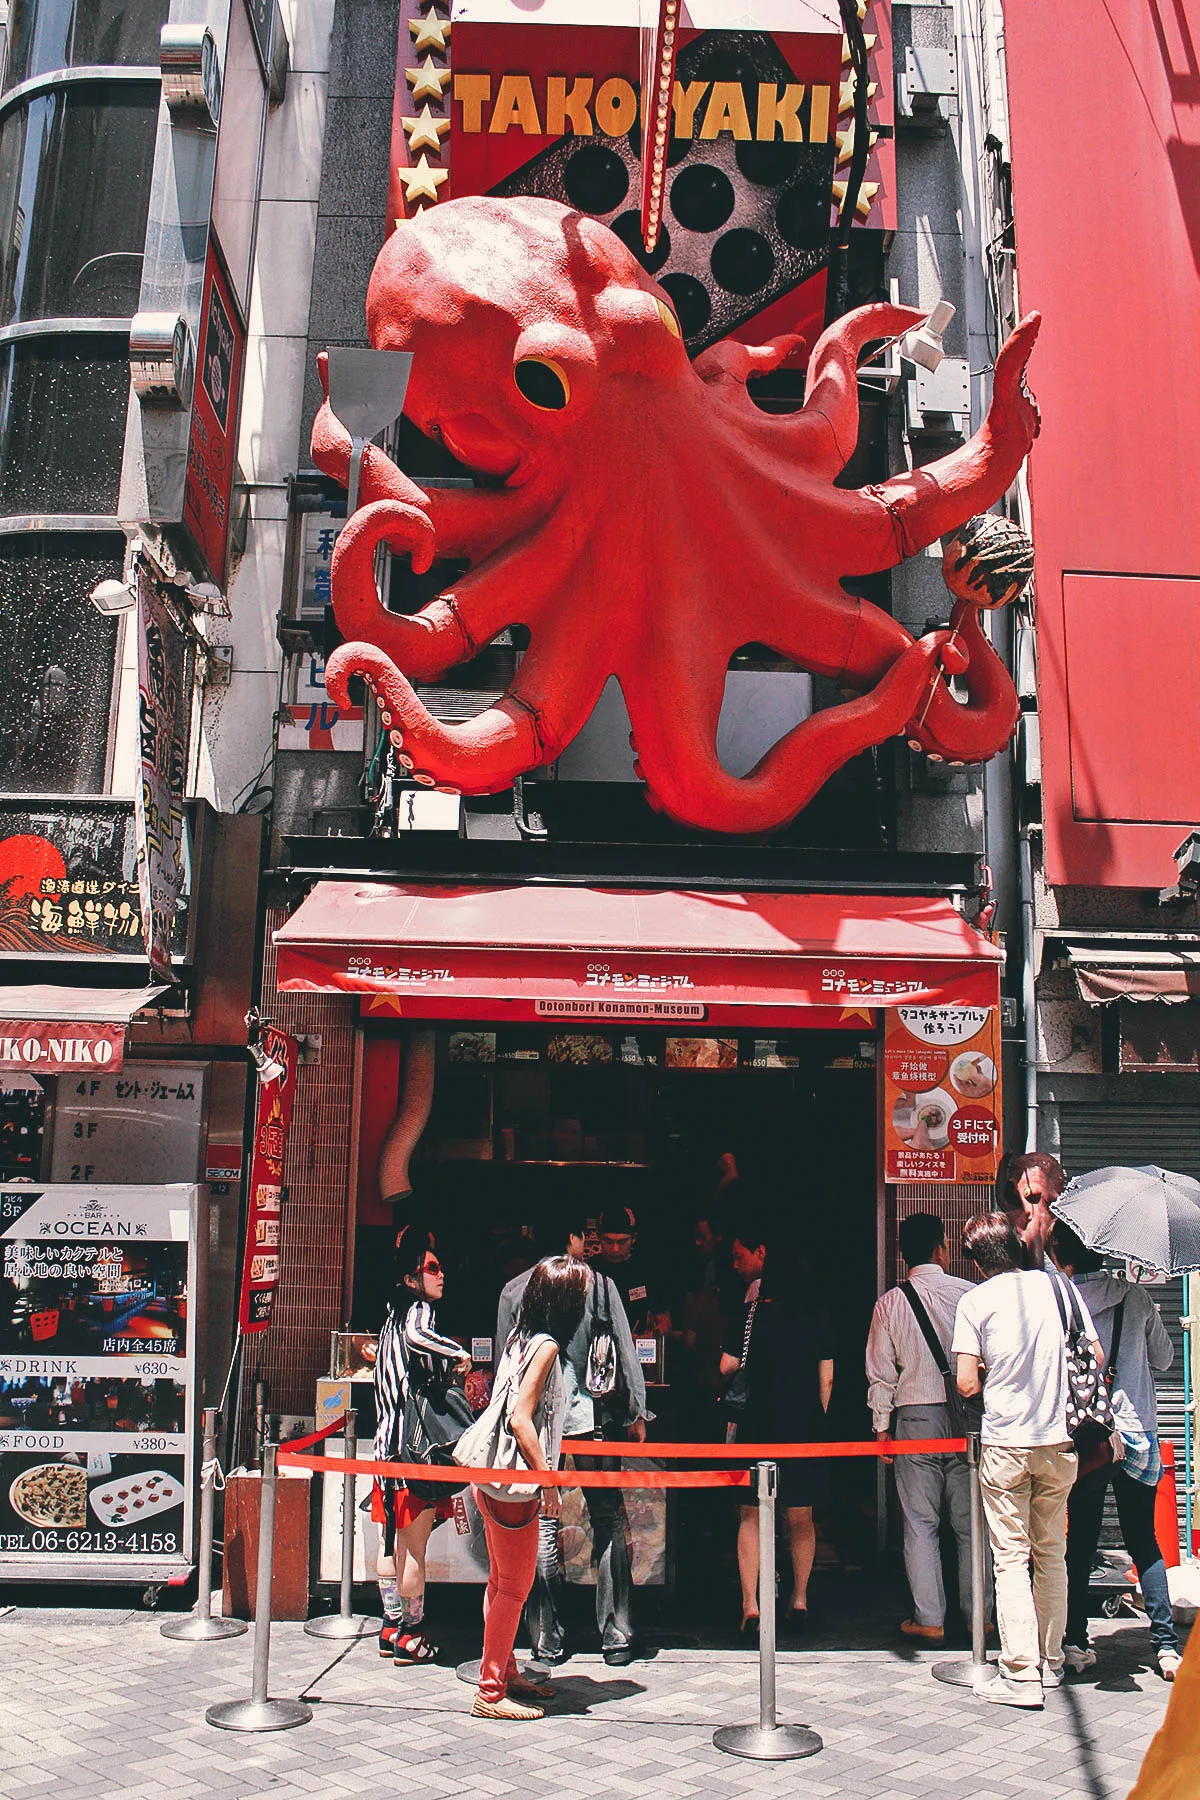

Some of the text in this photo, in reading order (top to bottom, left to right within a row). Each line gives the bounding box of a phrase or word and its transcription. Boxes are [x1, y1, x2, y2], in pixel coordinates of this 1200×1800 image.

[454, 74, 830, 143] TAKOYAKI
[30, 899, 145, 937] 海鮮物
[821, 978, 931, 993] コナモンミュージアム
[539, 1001, 701, 1015] Dotonbori Konamon-Museum
[0, 1037, 113, 1063] KO-NIKO
[76, 1081, 100, 1096] 4F
[115, 1081, 194, 1100] セント・ジェームス
[73, 1123, 98, 1138] 3F
[957, 1132, 990, 1143] 受付中
[70, 1165, 95, 1180] 2F
[207, 1169, 240, 1178] SECOM
[2, 1203, 22, 1217] 3F
[54, 1221, 131, 1236] OCEAN
[4, 1245, 124, 1261] 美味しいカクテルと
[3, 1262, 122, 1278] 居心地の良い空間
[102, 1338, 177, 1353] 店内全45席
[15, 1360, 77, 1373] DRINK
[13, 1436, 64, 1448] FOOD
[0, 1531, 177, 1552] TEL 06-6213-4158
